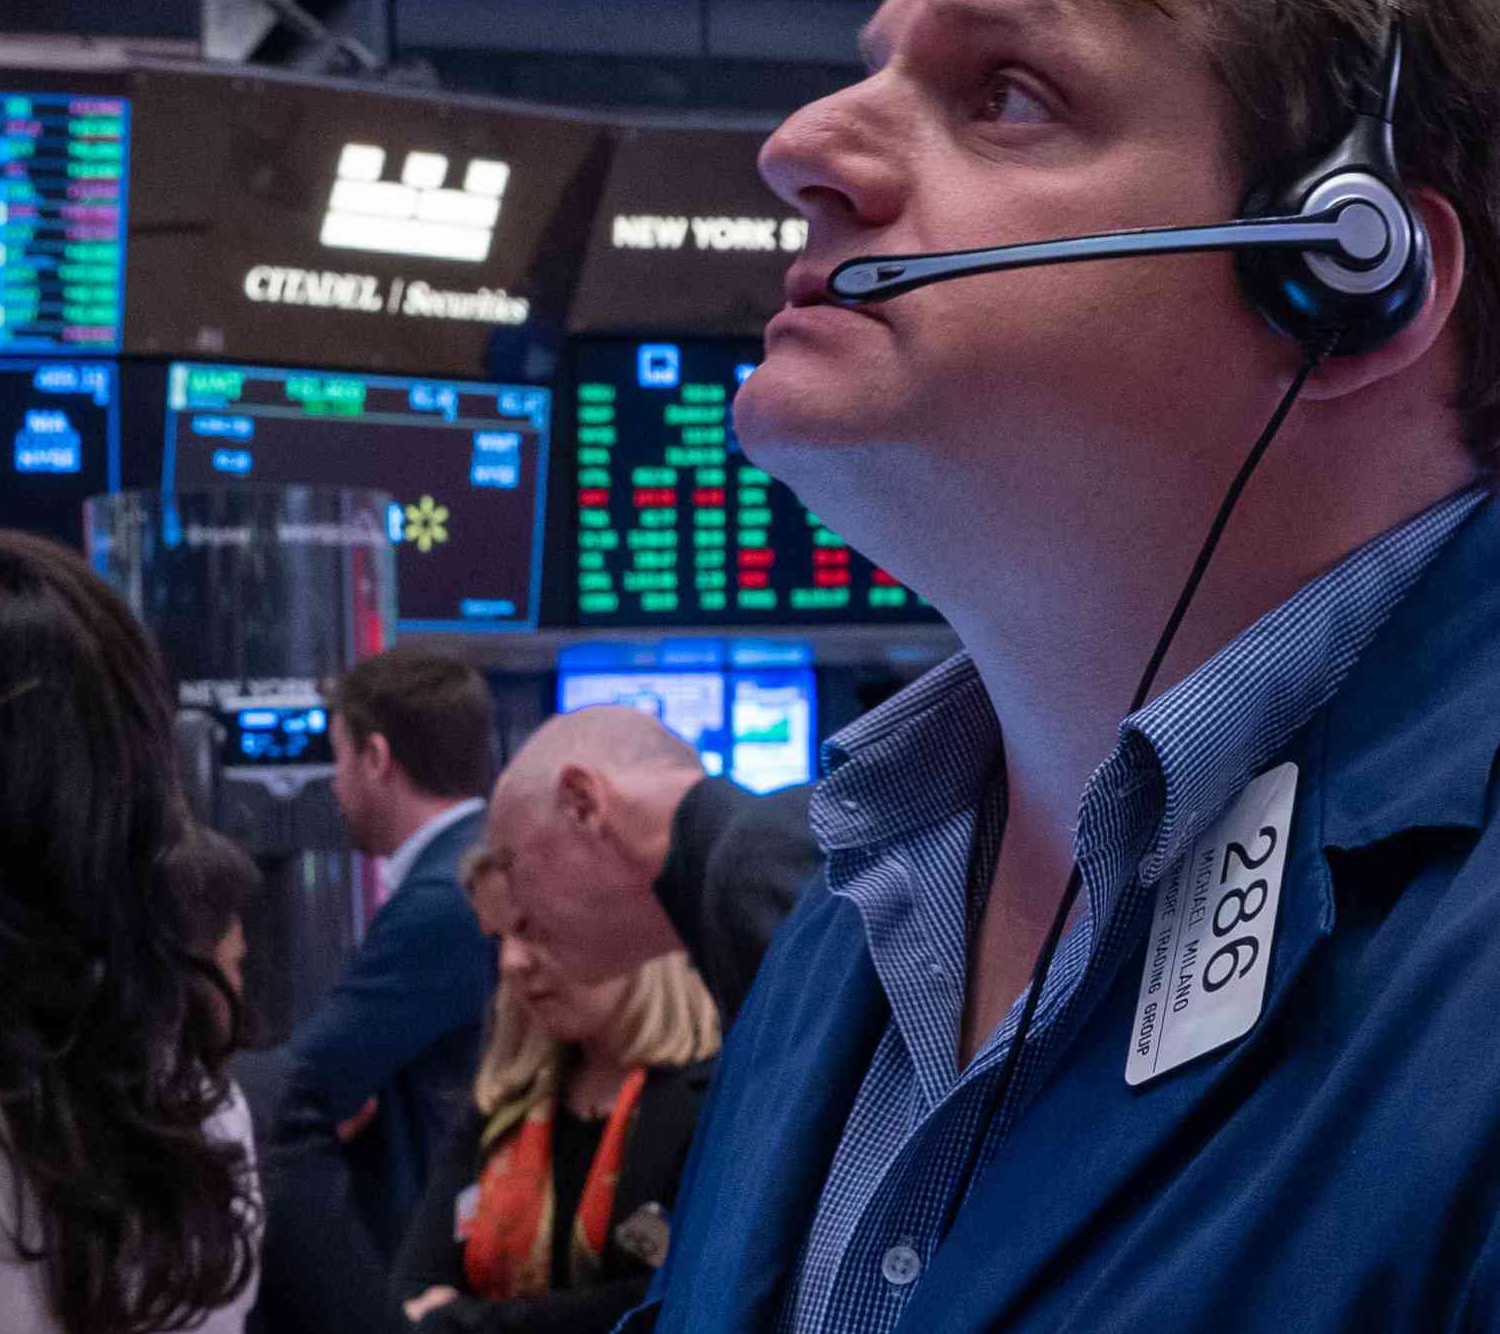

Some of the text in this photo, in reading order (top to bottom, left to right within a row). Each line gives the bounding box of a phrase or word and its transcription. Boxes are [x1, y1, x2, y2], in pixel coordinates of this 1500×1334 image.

[612, 214, 689, 250] NEW
[690, 215, 778, 252] YORK
[244, 264, 530, 326] CITADEL Securities
[1172, 847, 1215, 1013] MICHAEL MILANO
[1202, 825, 1278, 994] 286
[1146, 928, 1173, 995] TRADING
[1135, 1001, 1158, 1056] GROUP
